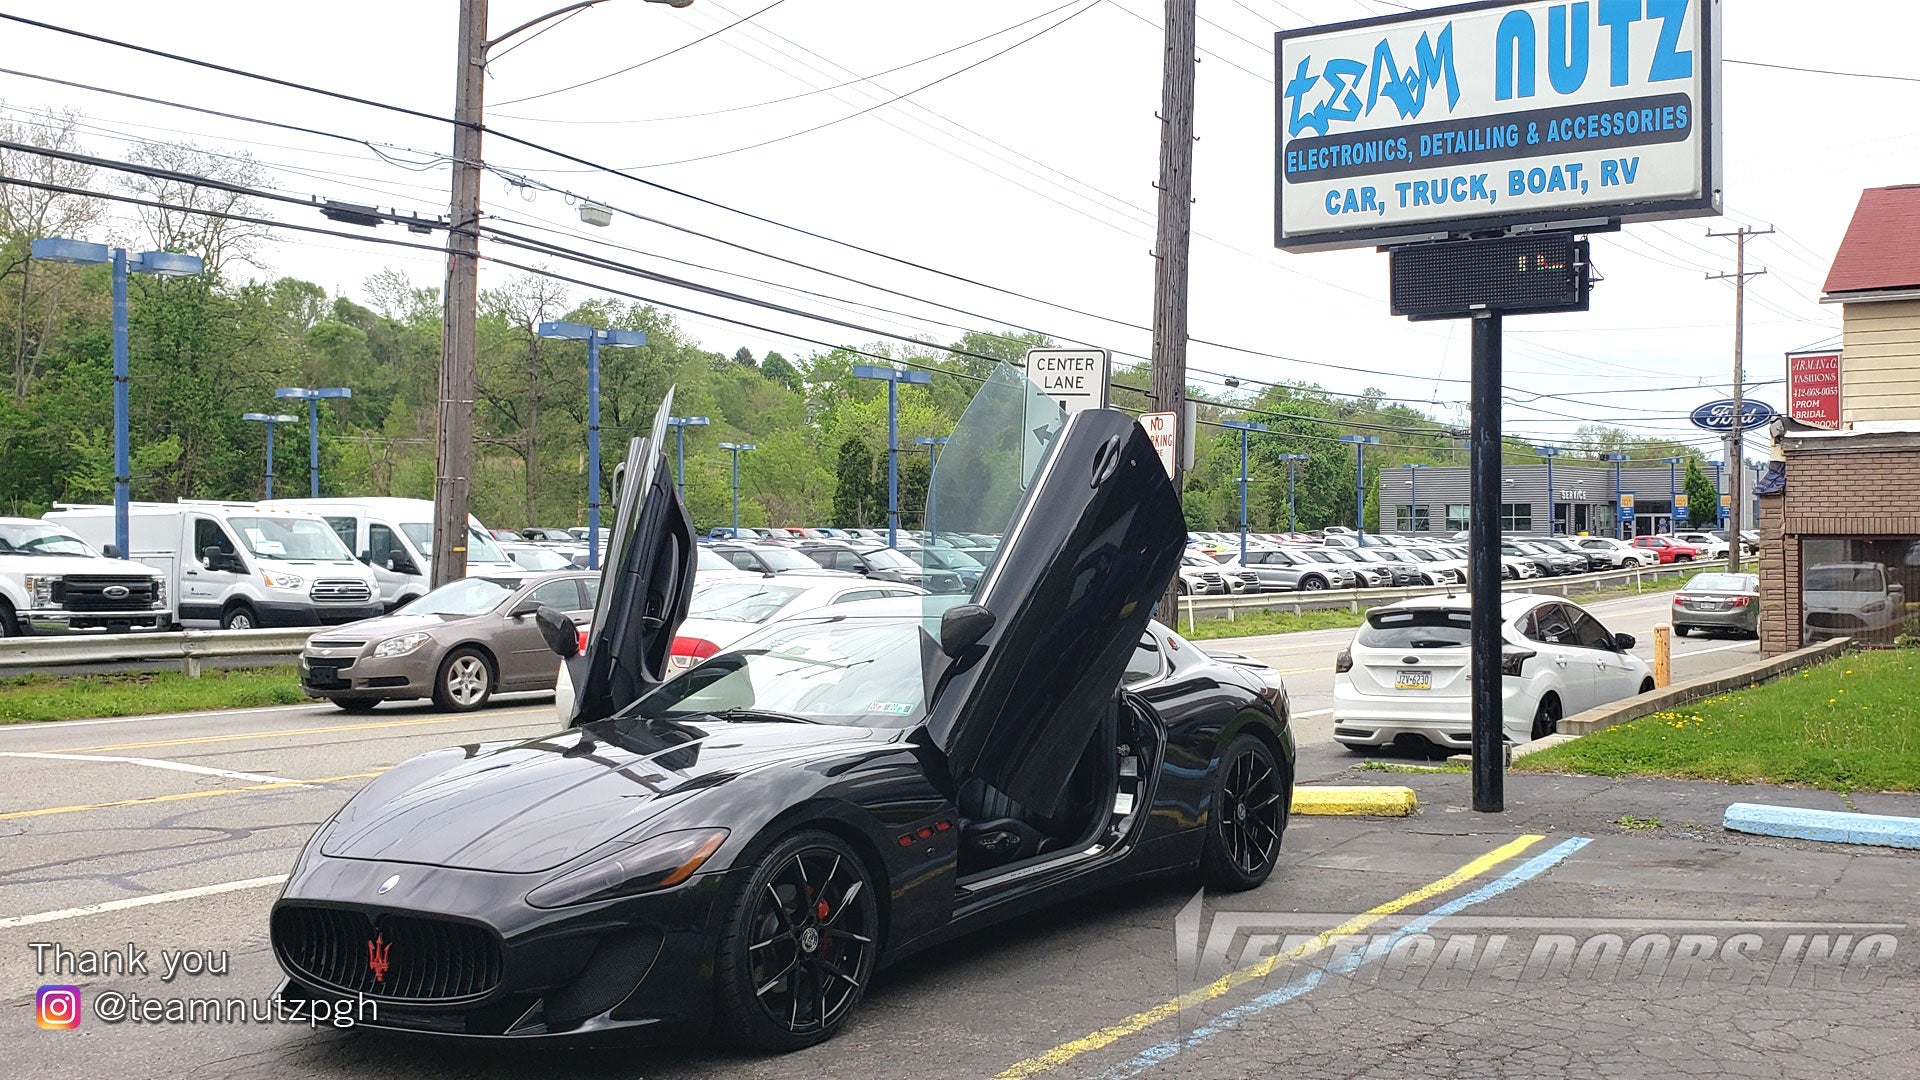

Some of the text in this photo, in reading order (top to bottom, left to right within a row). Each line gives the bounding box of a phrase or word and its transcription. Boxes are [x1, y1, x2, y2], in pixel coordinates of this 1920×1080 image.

[1287, 105, 1688, 173] ELECTRONICS, DETAILING & ACCESSORIES
[1325, 157, 1640, 215] CAR, TRUCK, BOAT, RV
[1037, 358, 1094, 371] CENTER
[1044, 376, 1084, 389] LANE
[1794, 373, 1836, 383] FASHIONS
[1706, 404, 1758, 426] Fod
[1150, 417, 1164, 431] NO
[1150, 434, 1173, 447] RKING
